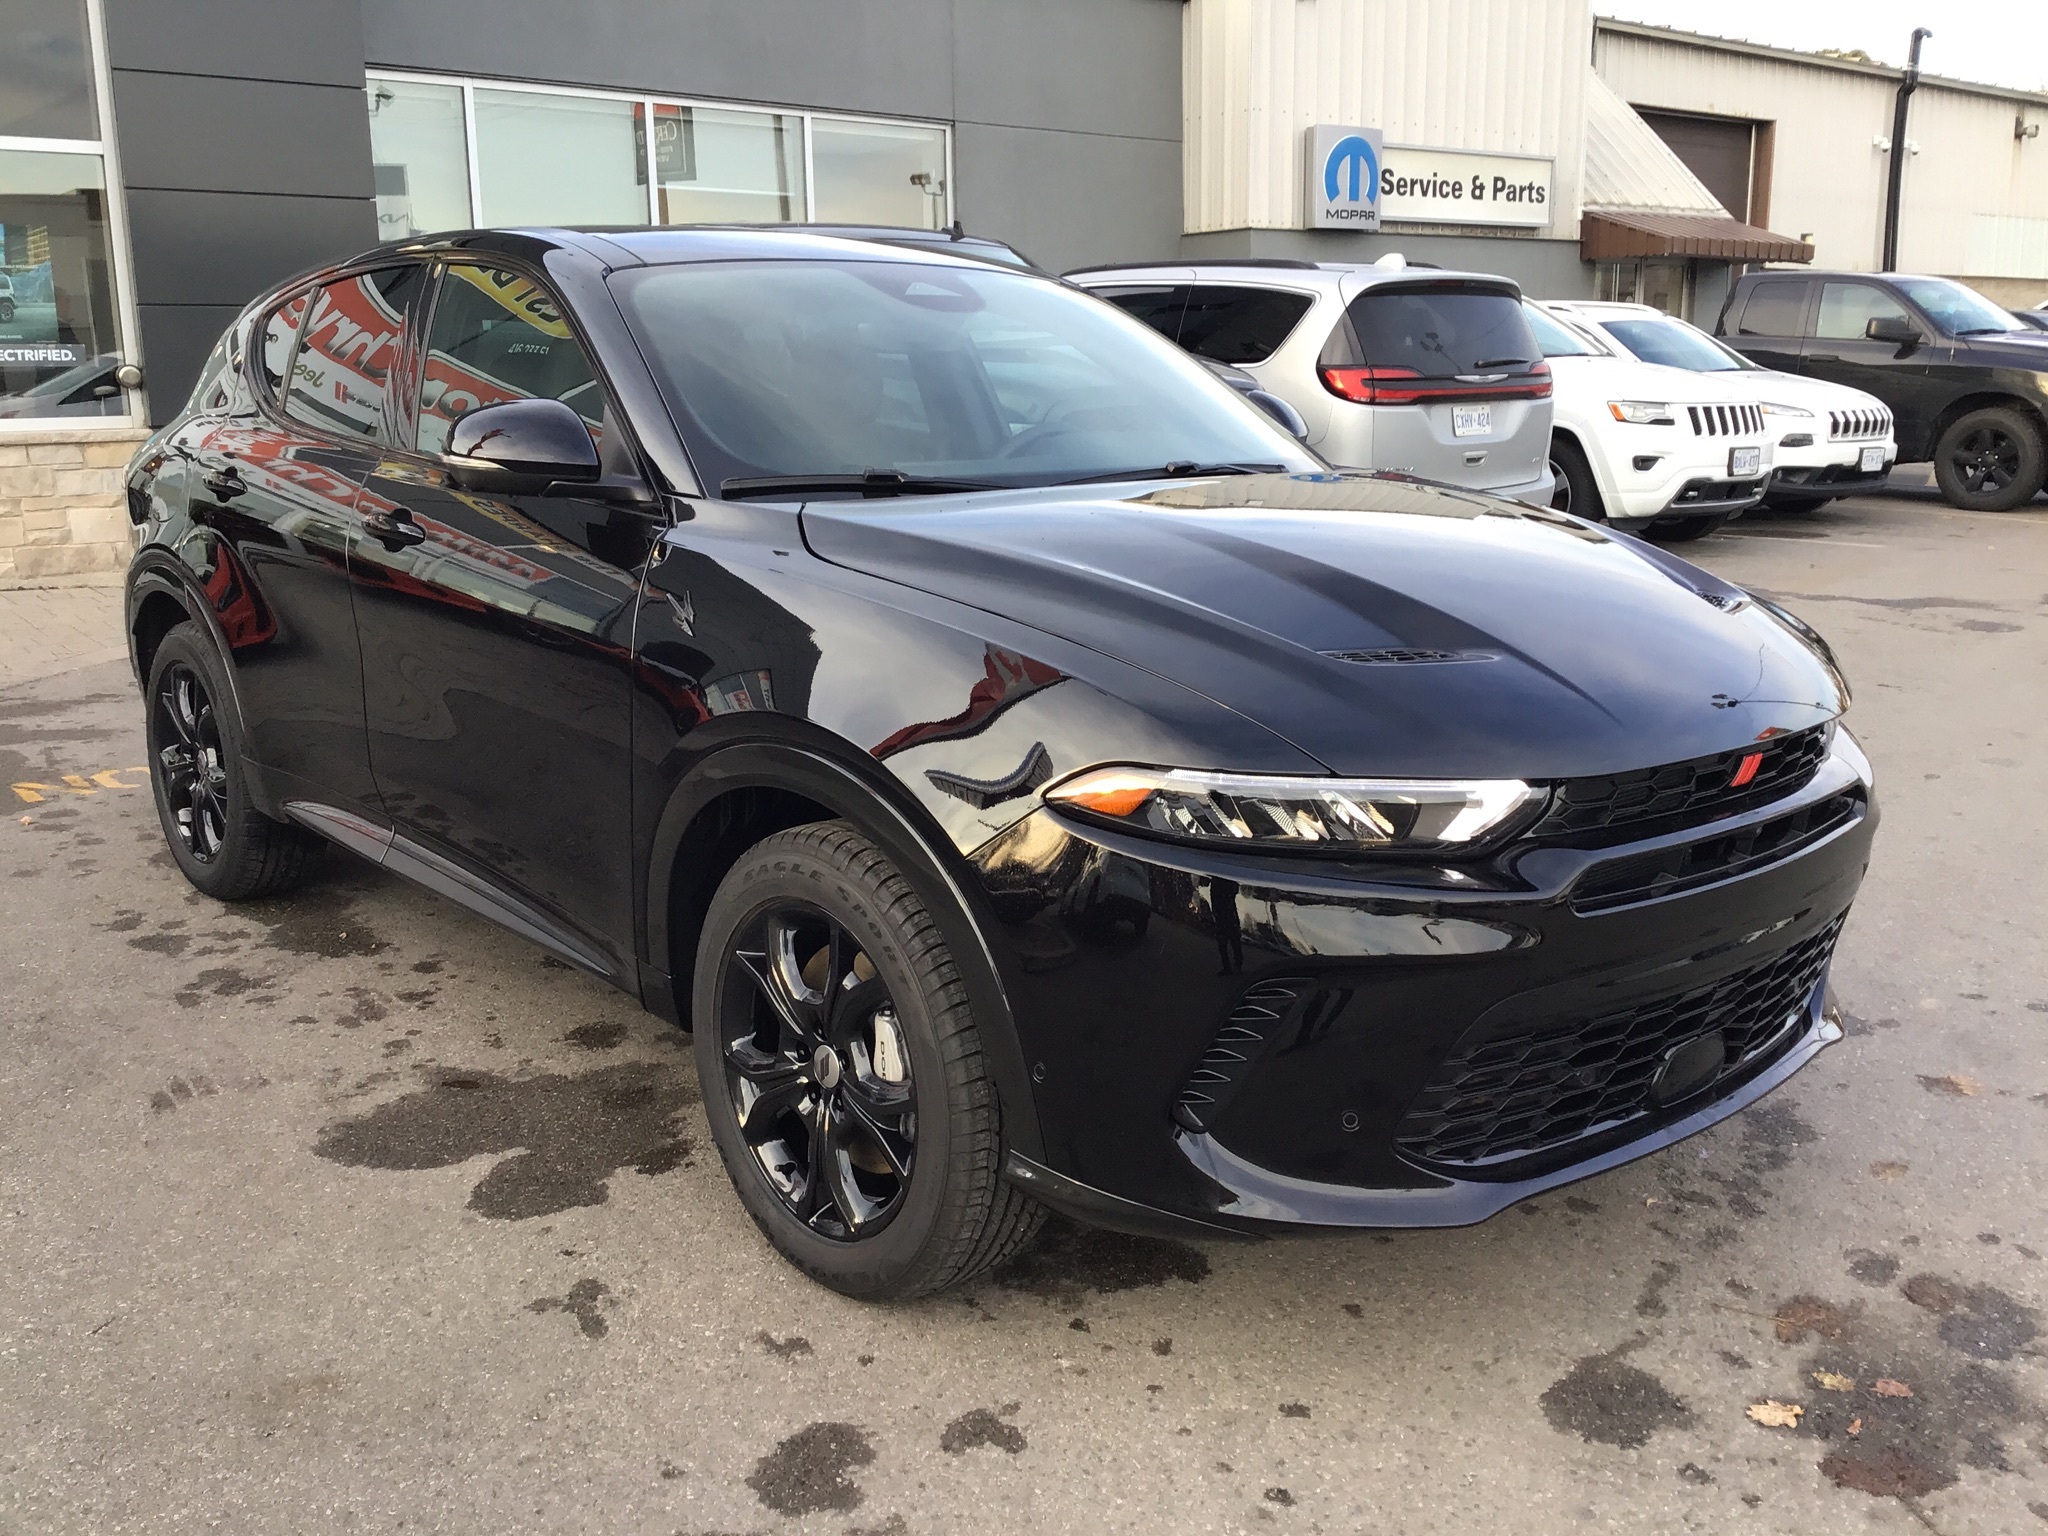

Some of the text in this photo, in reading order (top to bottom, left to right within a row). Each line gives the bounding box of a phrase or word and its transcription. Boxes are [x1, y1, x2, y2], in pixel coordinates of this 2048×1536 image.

[1380, 168, 1546, 204] Service & Parts
[1326, 208, 1376, 221] MOPAR
[743, 860, 826, 884] EAGLE
